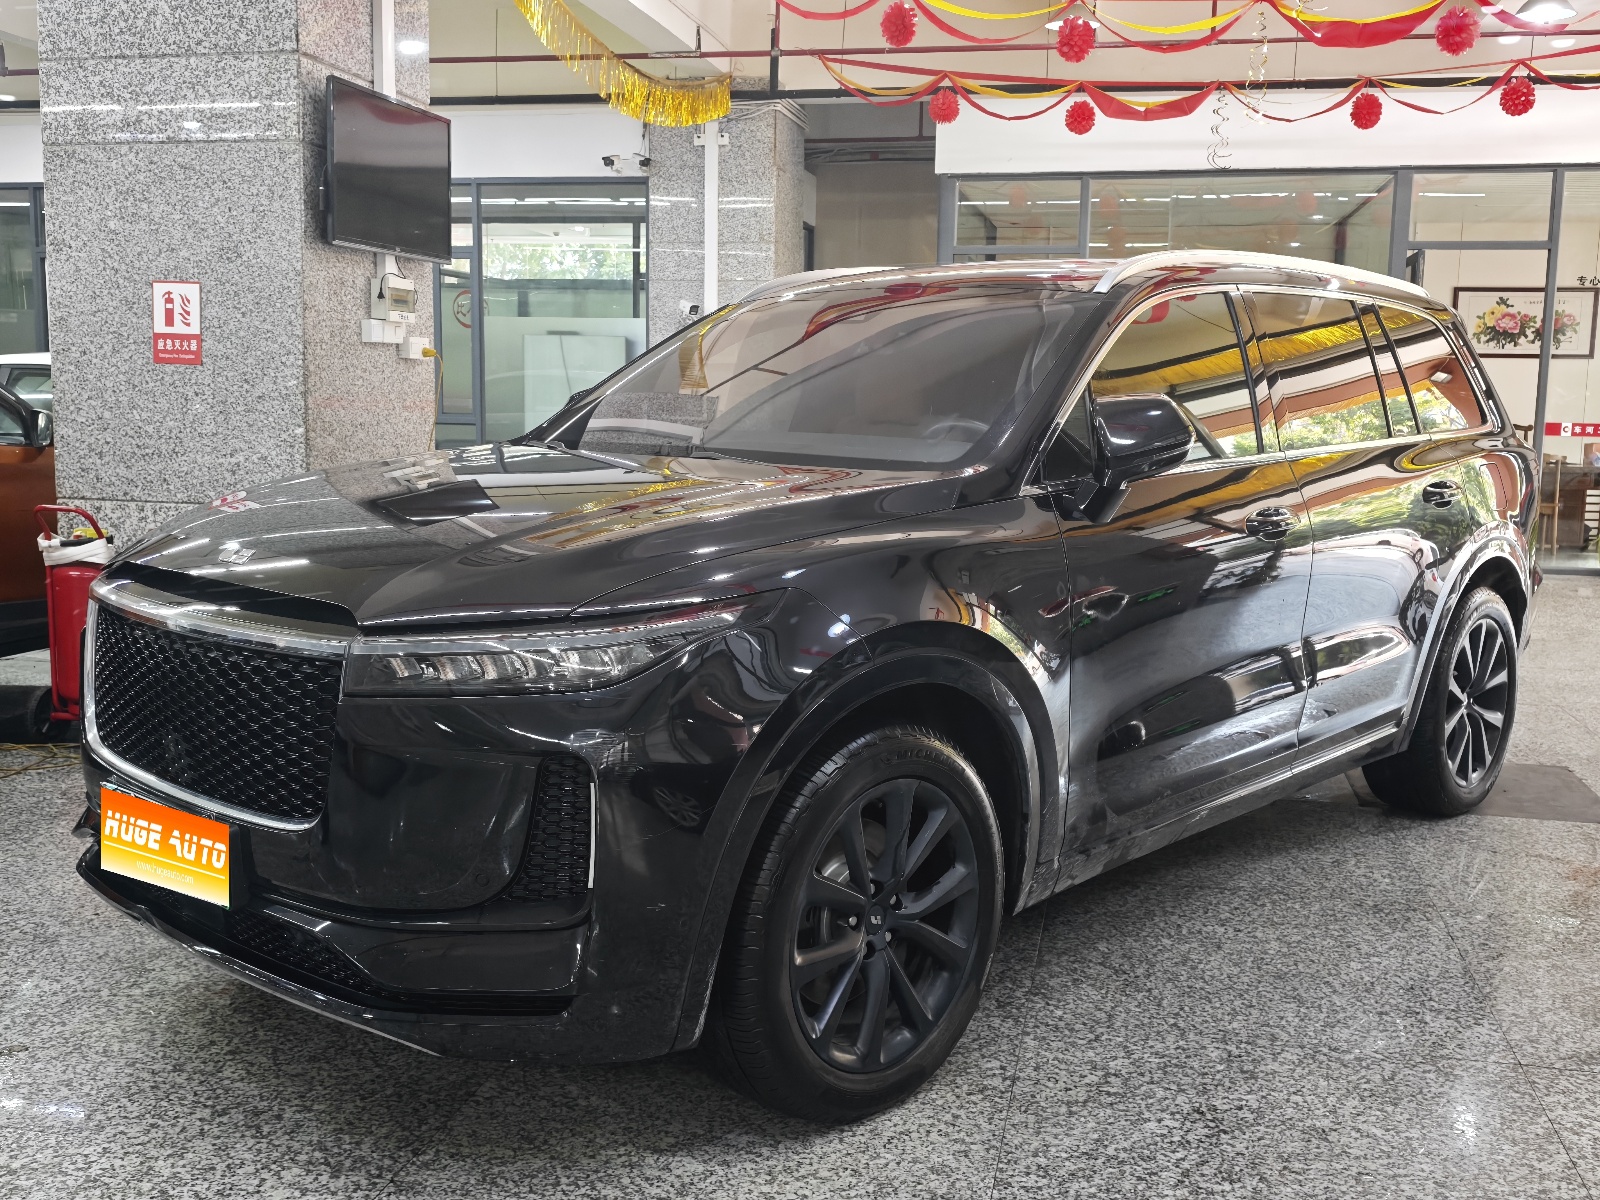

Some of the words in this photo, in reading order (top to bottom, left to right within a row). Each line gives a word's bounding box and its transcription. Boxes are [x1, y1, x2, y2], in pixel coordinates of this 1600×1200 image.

[1577, 275, 1600, 286] 专心
[157, 338, 198, 351] 应急灭火器
